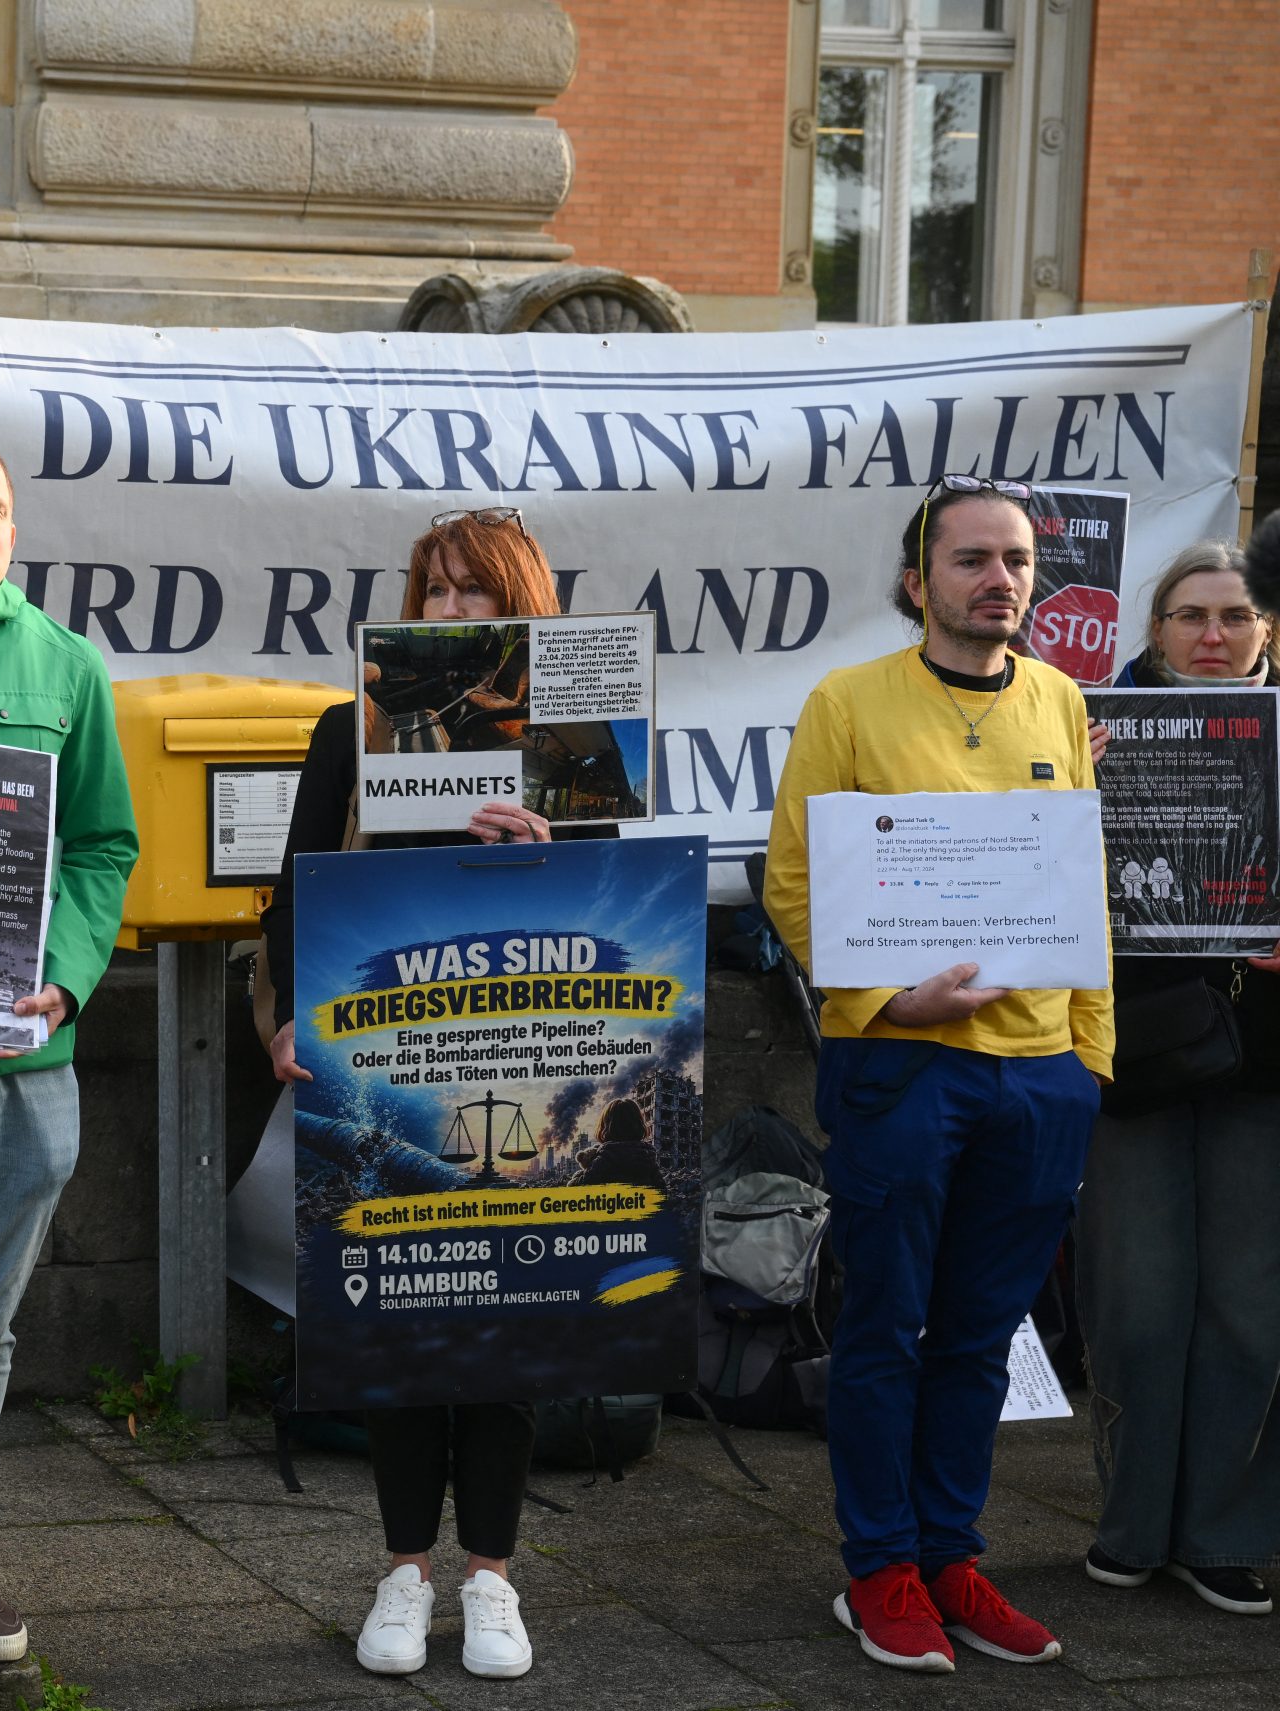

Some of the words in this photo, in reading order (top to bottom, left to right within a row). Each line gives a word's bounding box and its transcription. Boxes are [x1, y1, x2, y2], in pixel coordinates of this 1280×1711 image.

[29, 388, 234, 486] DIE
[259, 402, 770, 492] UKRAINE
[793, 391, 1175, 490] FALLEN
[1068, 518, 1109, 540] EITHER
[10, 560, 223, 654] IRD
[538, 630, 550, 638] Bei
[579, 627, 620, 636] russischen
[538, 635, 599, 645] Drohnenangriff
[600, 635, 613, 643] auf
[572, 643, 615, 652] Marhanets
[1142, 719, 1154, 739] IS
[1157, 718, 1203, 739] SIMPLY
[1208, 718, 1225, 739] NO
[1228, 718, 1260, 739] FOOD
[2, 781, 16, 795] HAS
[17, 783, 35, 798] BEEN
[365, 776, 516, 797] MARHANETS
[0, 829, 11, 838] the
[953, 838, 979, 846] patrons
[868, 917, 895, 928] Nord
[898, 918, 938, 927] Stream
[942, 917, 980, 927] bauen:
[984, 915, 1055, 926] Verbrechen!
[846, 937, 874, 947] Nord
[877, 937, 917, 947] Stream
[921, 938, 976, 948] sprengen:
[980, 936, 1004, 946] kein
[1007, 934, 1079, 945] Verbrechen!
[395, 947, 491, 986] WAS
[502, 936, 597, 975] SIND
[333, 978, 672, 1034] KRIEGSVERBRECHEN?
[397, 1030, 433, 1047] Eine
[437, 1026, 527, 1048] gesprengte
[532, 1020, 605, 1040] Pipeline?
[352, 1051, 392, 1068] Oder
[396, 1049, 420, 1066] die
[425, 1045, 542, 1065] Bombardierung
[546, 1045, 573, 1057] von
[576, 1039, 652, 1056] Gebäuden
[390, 1070, 420, 1085] und
[424, 1068, 452, 1083] das
[456, 1066, 497, 1083] Töten
[501, 1067, 529, 1080] von
[532, 1060, 617, 1079] Menschen?
[362, 1208, 410, 1227] Recht
[413, 1206, 433, 1222] ist
[438, 1202, 478, 1221] nicht
[482, 1201, 536, 1217] immer
[540, 1192, 646, 1216] Gerechtigkeit
[378, 1240, 491, 1265] 14.10.2026
[553, 1235, 599, 1256] 8:00
[605, 1233, 647, 1253] UHR
[380, 1270, 498, 1296] HAMBURG
[379, 1296, 449, 1310] SOLIDARITÄT
[454, 1295, 471, 1306] MIT
[477, 1293, 500, 1305] DEM
[502, 1290, 580, 1304] ANGEKLAGTEN
